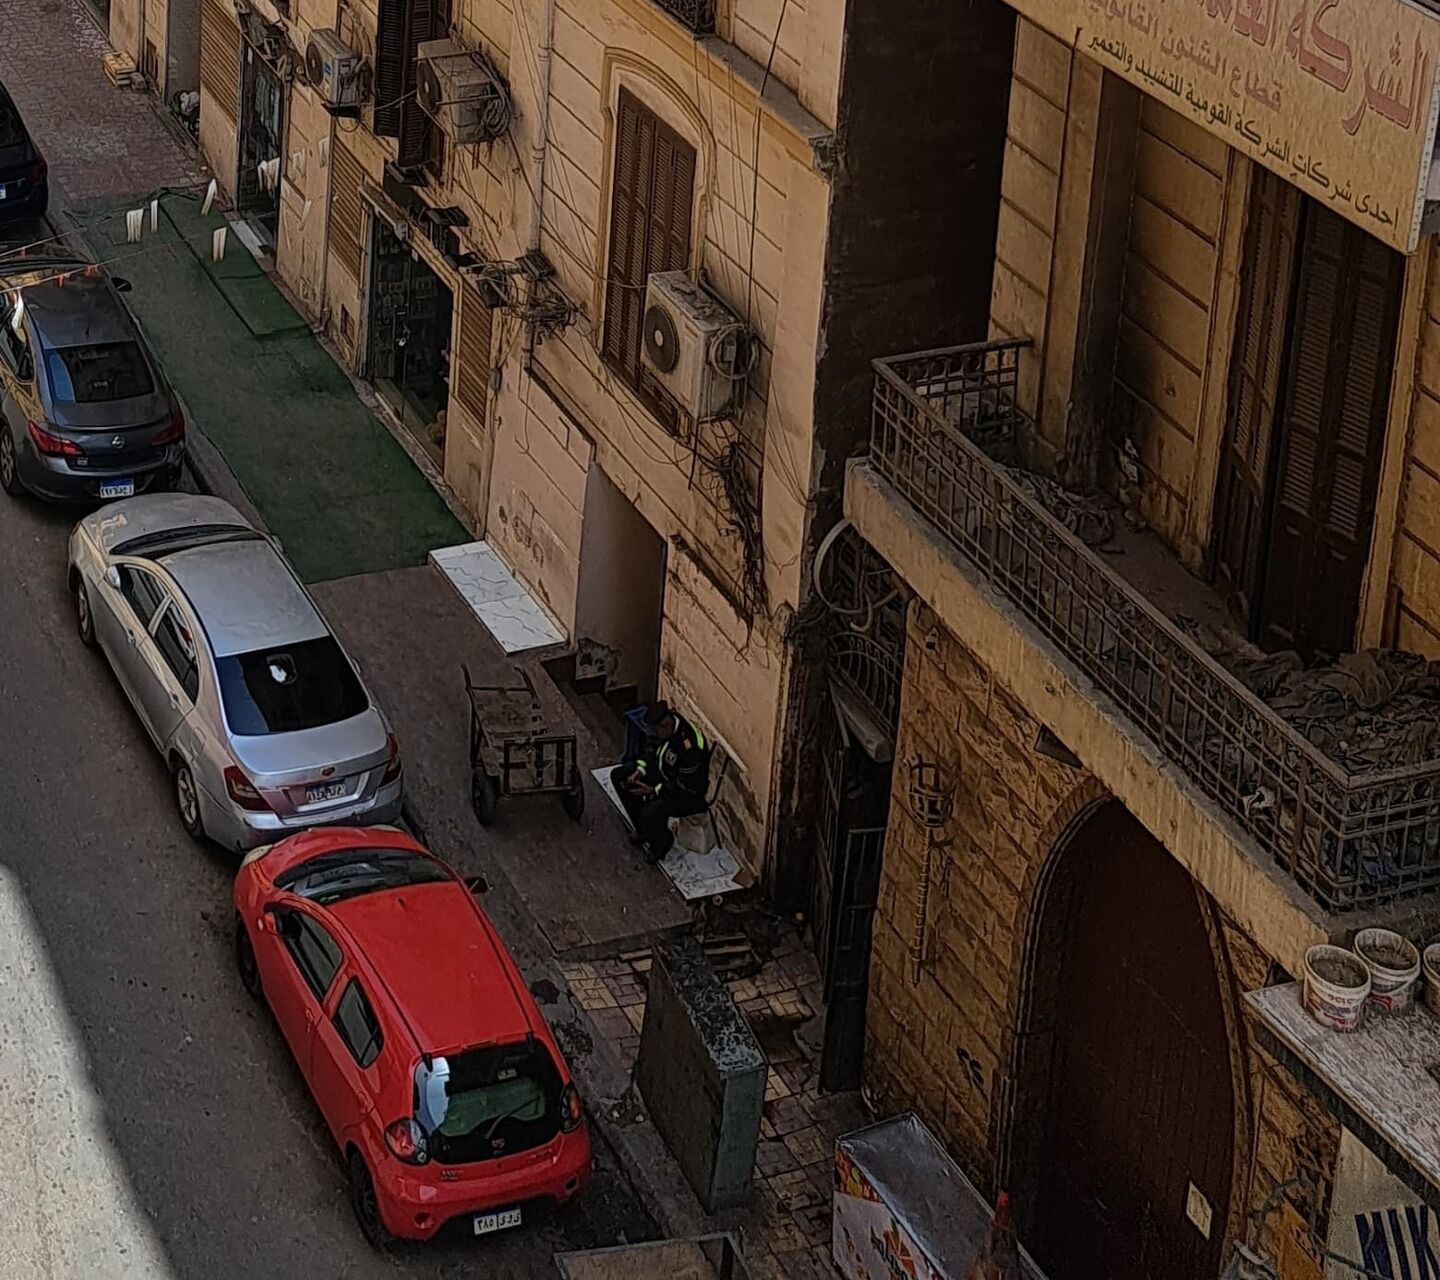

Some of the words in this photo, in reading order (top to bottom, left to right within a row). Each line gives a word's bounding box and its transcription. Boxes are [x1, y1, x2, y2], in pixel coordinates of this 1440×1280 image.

[1087, 34, 1134, 72] والتعمير
[1134, 56, 1183, 96] للتشييد
[1186, 82, 1233, 127] القومية
[1229, 65, 1281, 113] قطاع
[1235, 112, 1291, 162] الشركة
[1292, 154, 1352, 203] شركات
